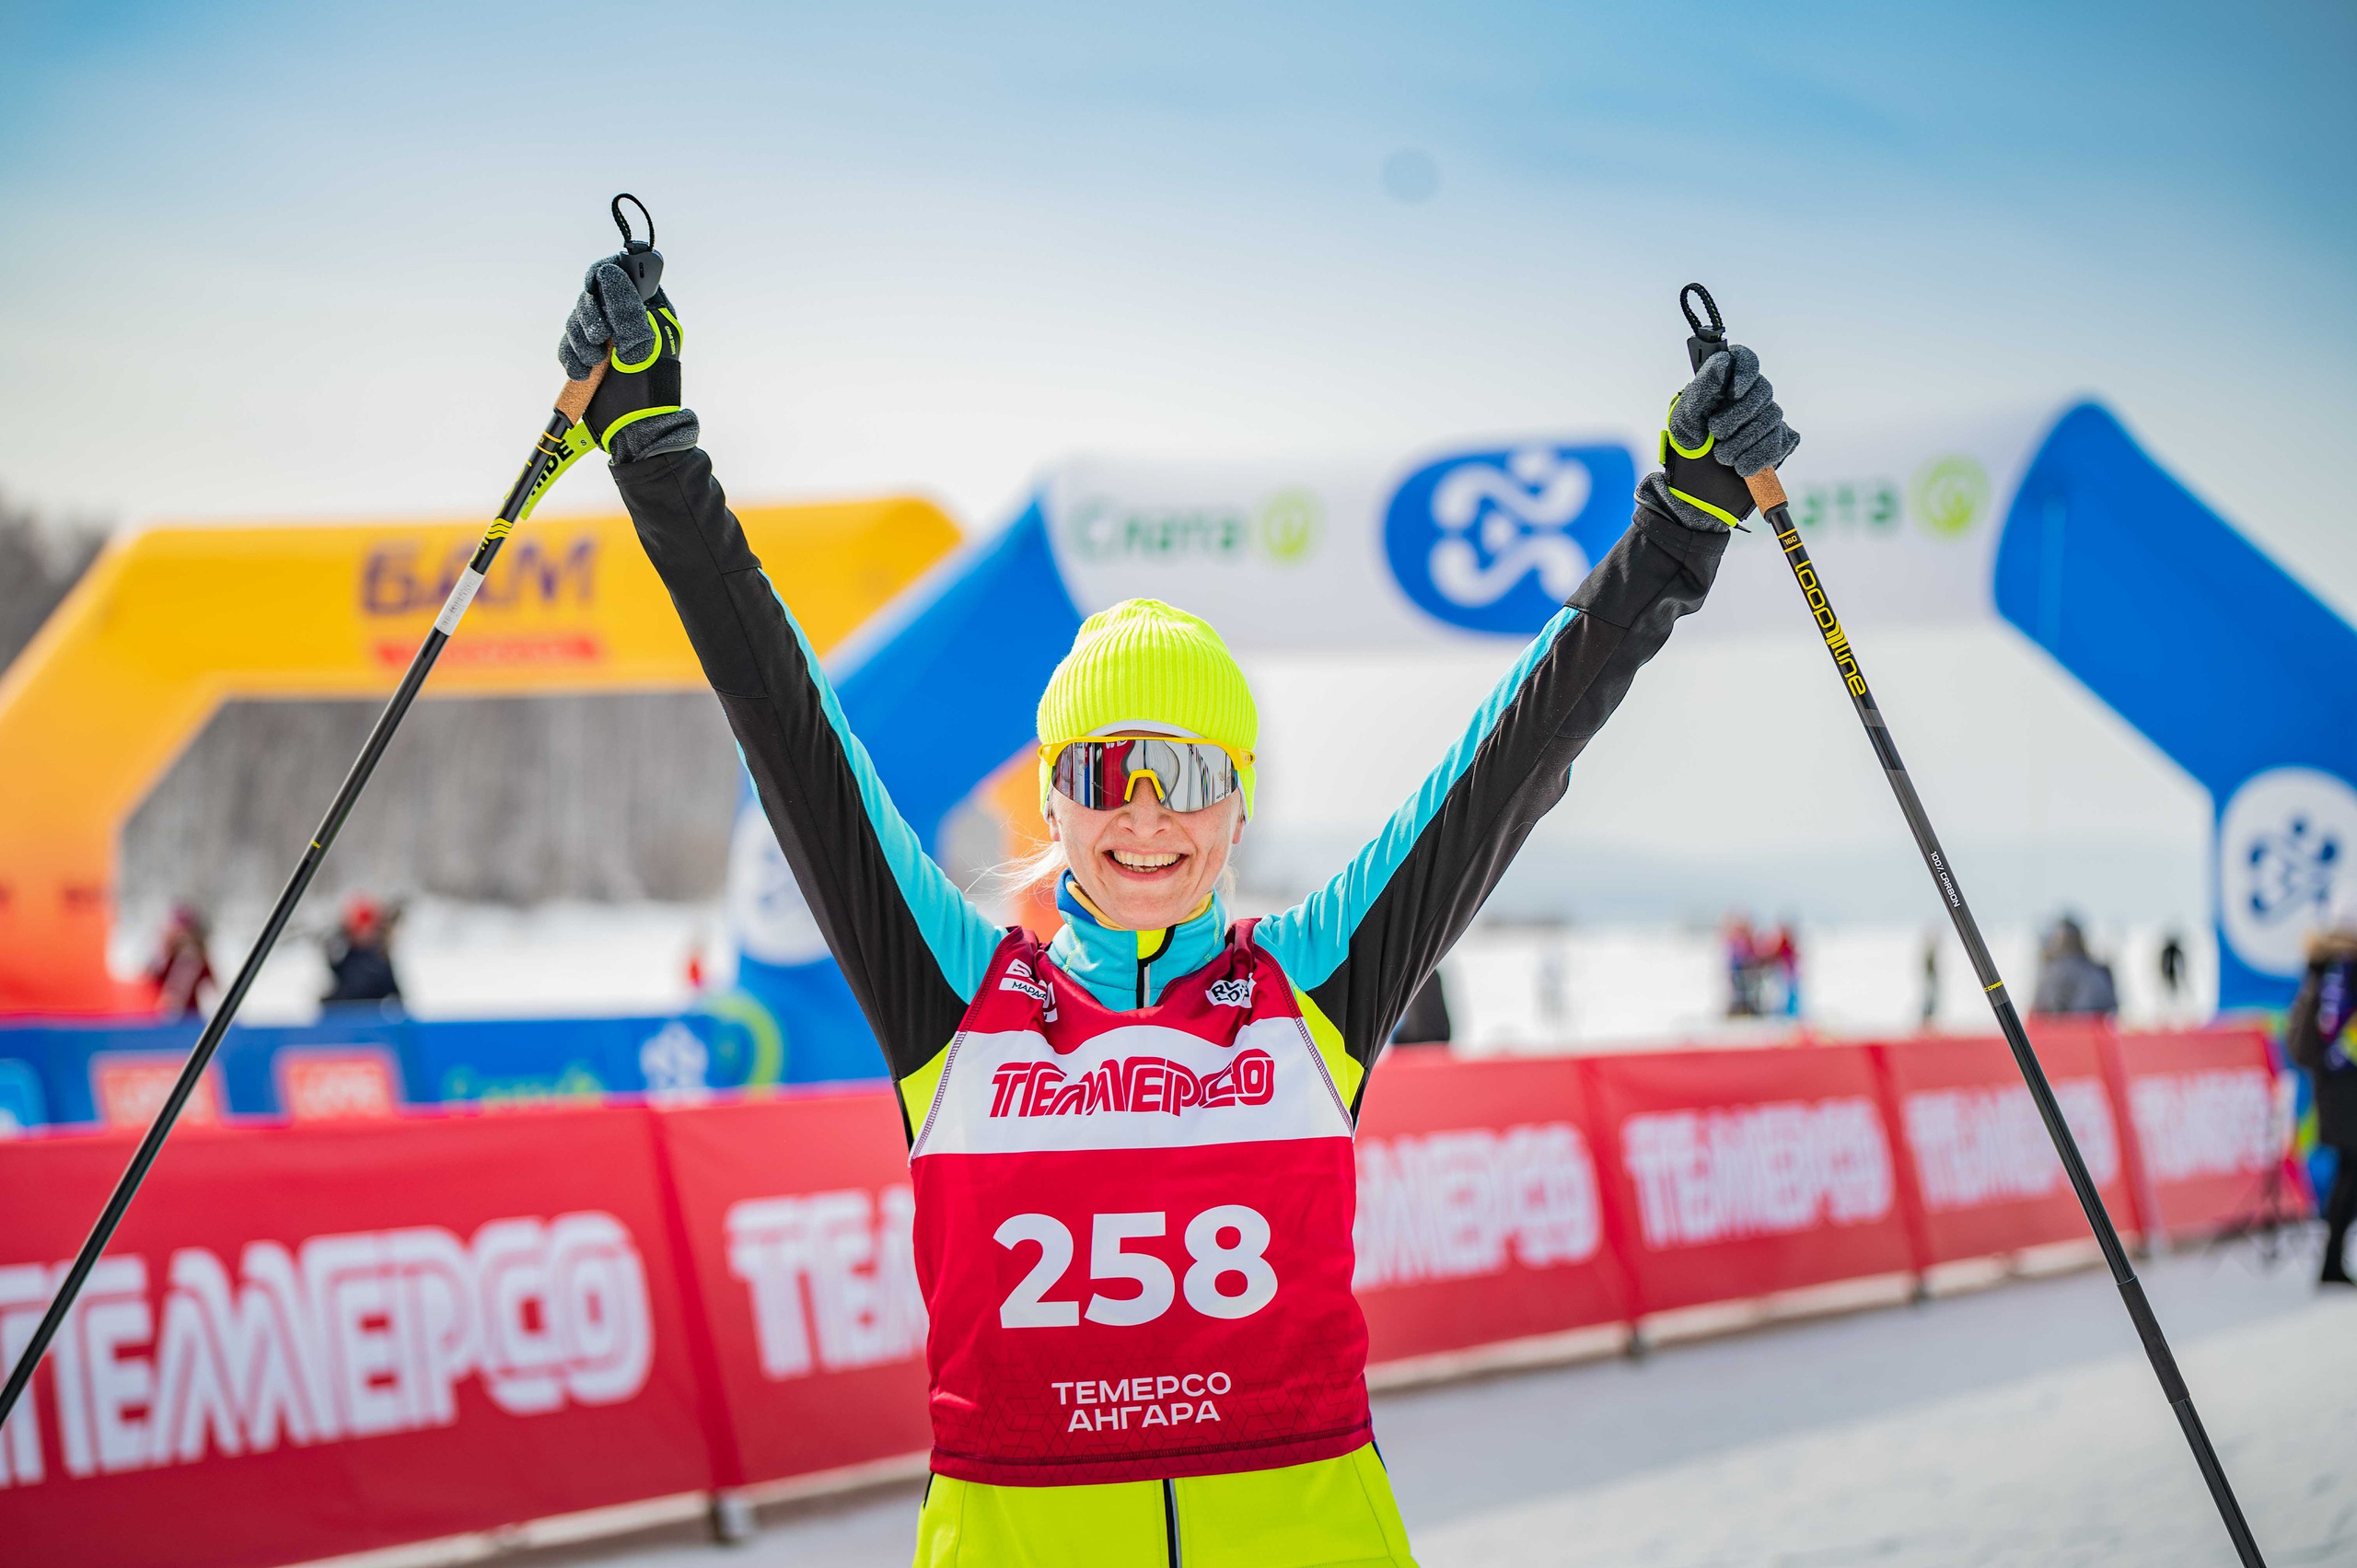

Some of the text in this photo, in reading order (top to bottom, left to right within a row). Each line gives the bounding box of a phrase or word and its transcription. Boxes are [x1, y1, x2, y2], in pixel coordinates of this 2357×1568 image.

[1783, 535, 1798, 545] 160
[1931, 851, 1961, 908] 100% CARBON
[993, 1204, 1279, 1329] 258
[1051, 1372, 1232, 1405] ТЕМЕРСО
[1067, 1400, 1221, 1433] АНГАРА
